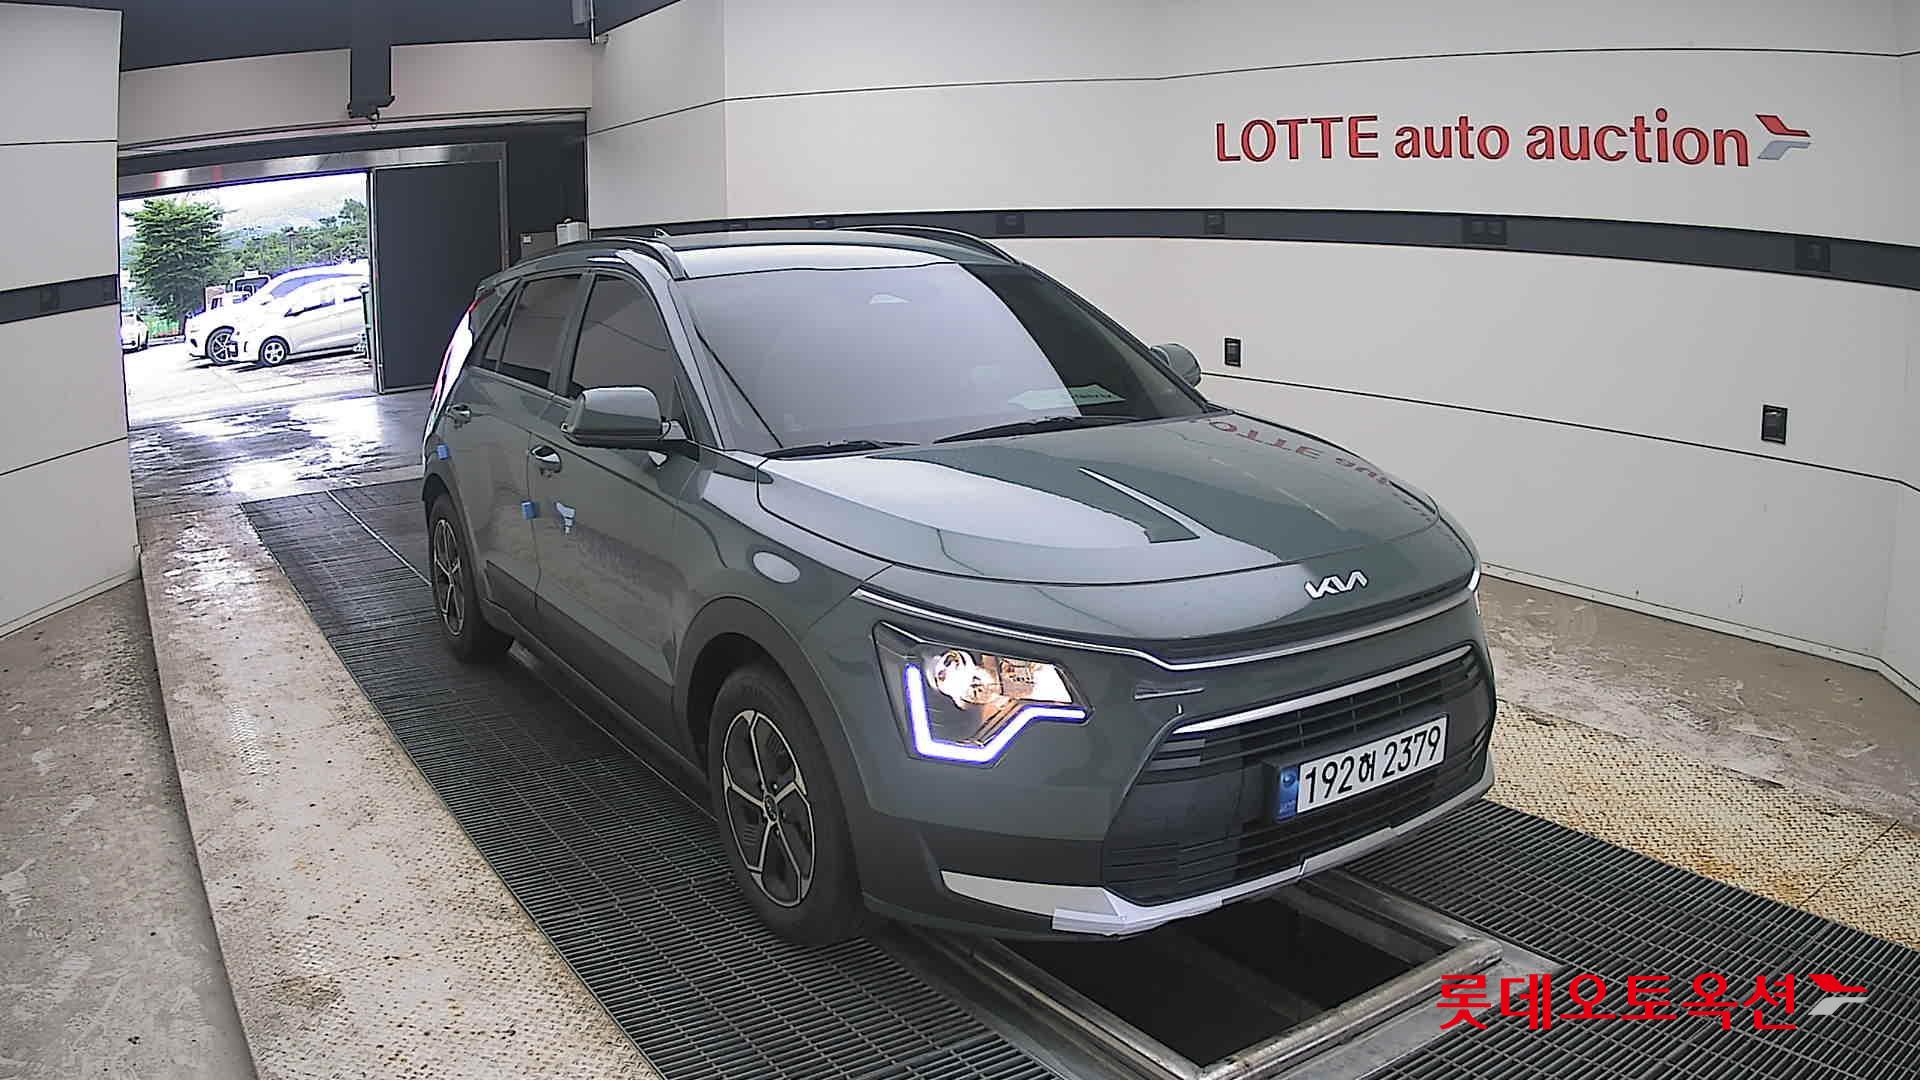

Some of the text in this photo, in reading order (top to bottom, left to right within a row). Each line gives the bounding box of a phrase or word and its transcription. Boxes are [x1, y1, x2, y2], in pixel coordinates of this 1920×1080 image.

[1215, 107, 1750, 167] LOTTE auto auction
[1304, 570, 1368, 599] KIA
[1305, 725, 1441, 803] 192허 2379
